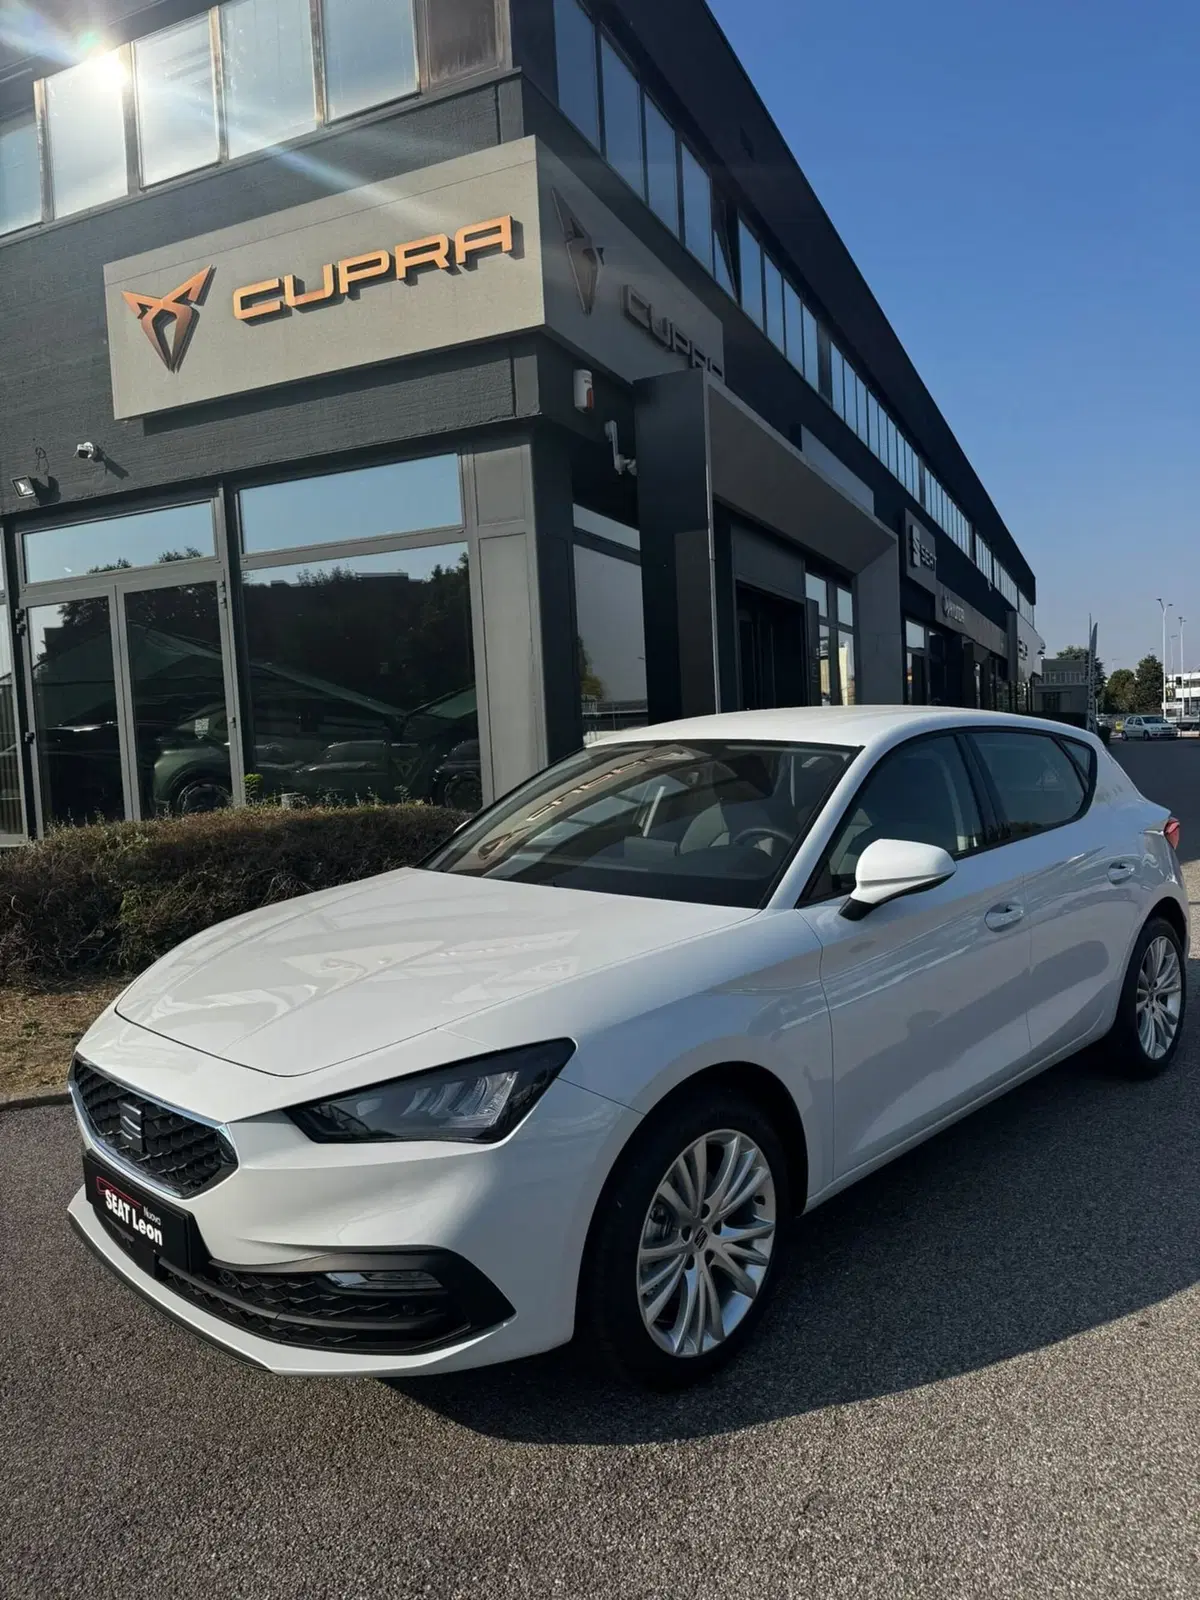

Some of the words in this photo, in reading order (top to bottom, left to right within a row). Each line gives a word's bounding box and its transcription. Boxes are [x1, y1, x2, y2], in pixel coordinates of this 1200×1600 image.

[233, 215, 513, 320] CUPRA
[105, 1189, 130, 1224] SEAT
[132, 1208, 163, 1247] Leon
[143, 1206, 161, 1226] Nuova
